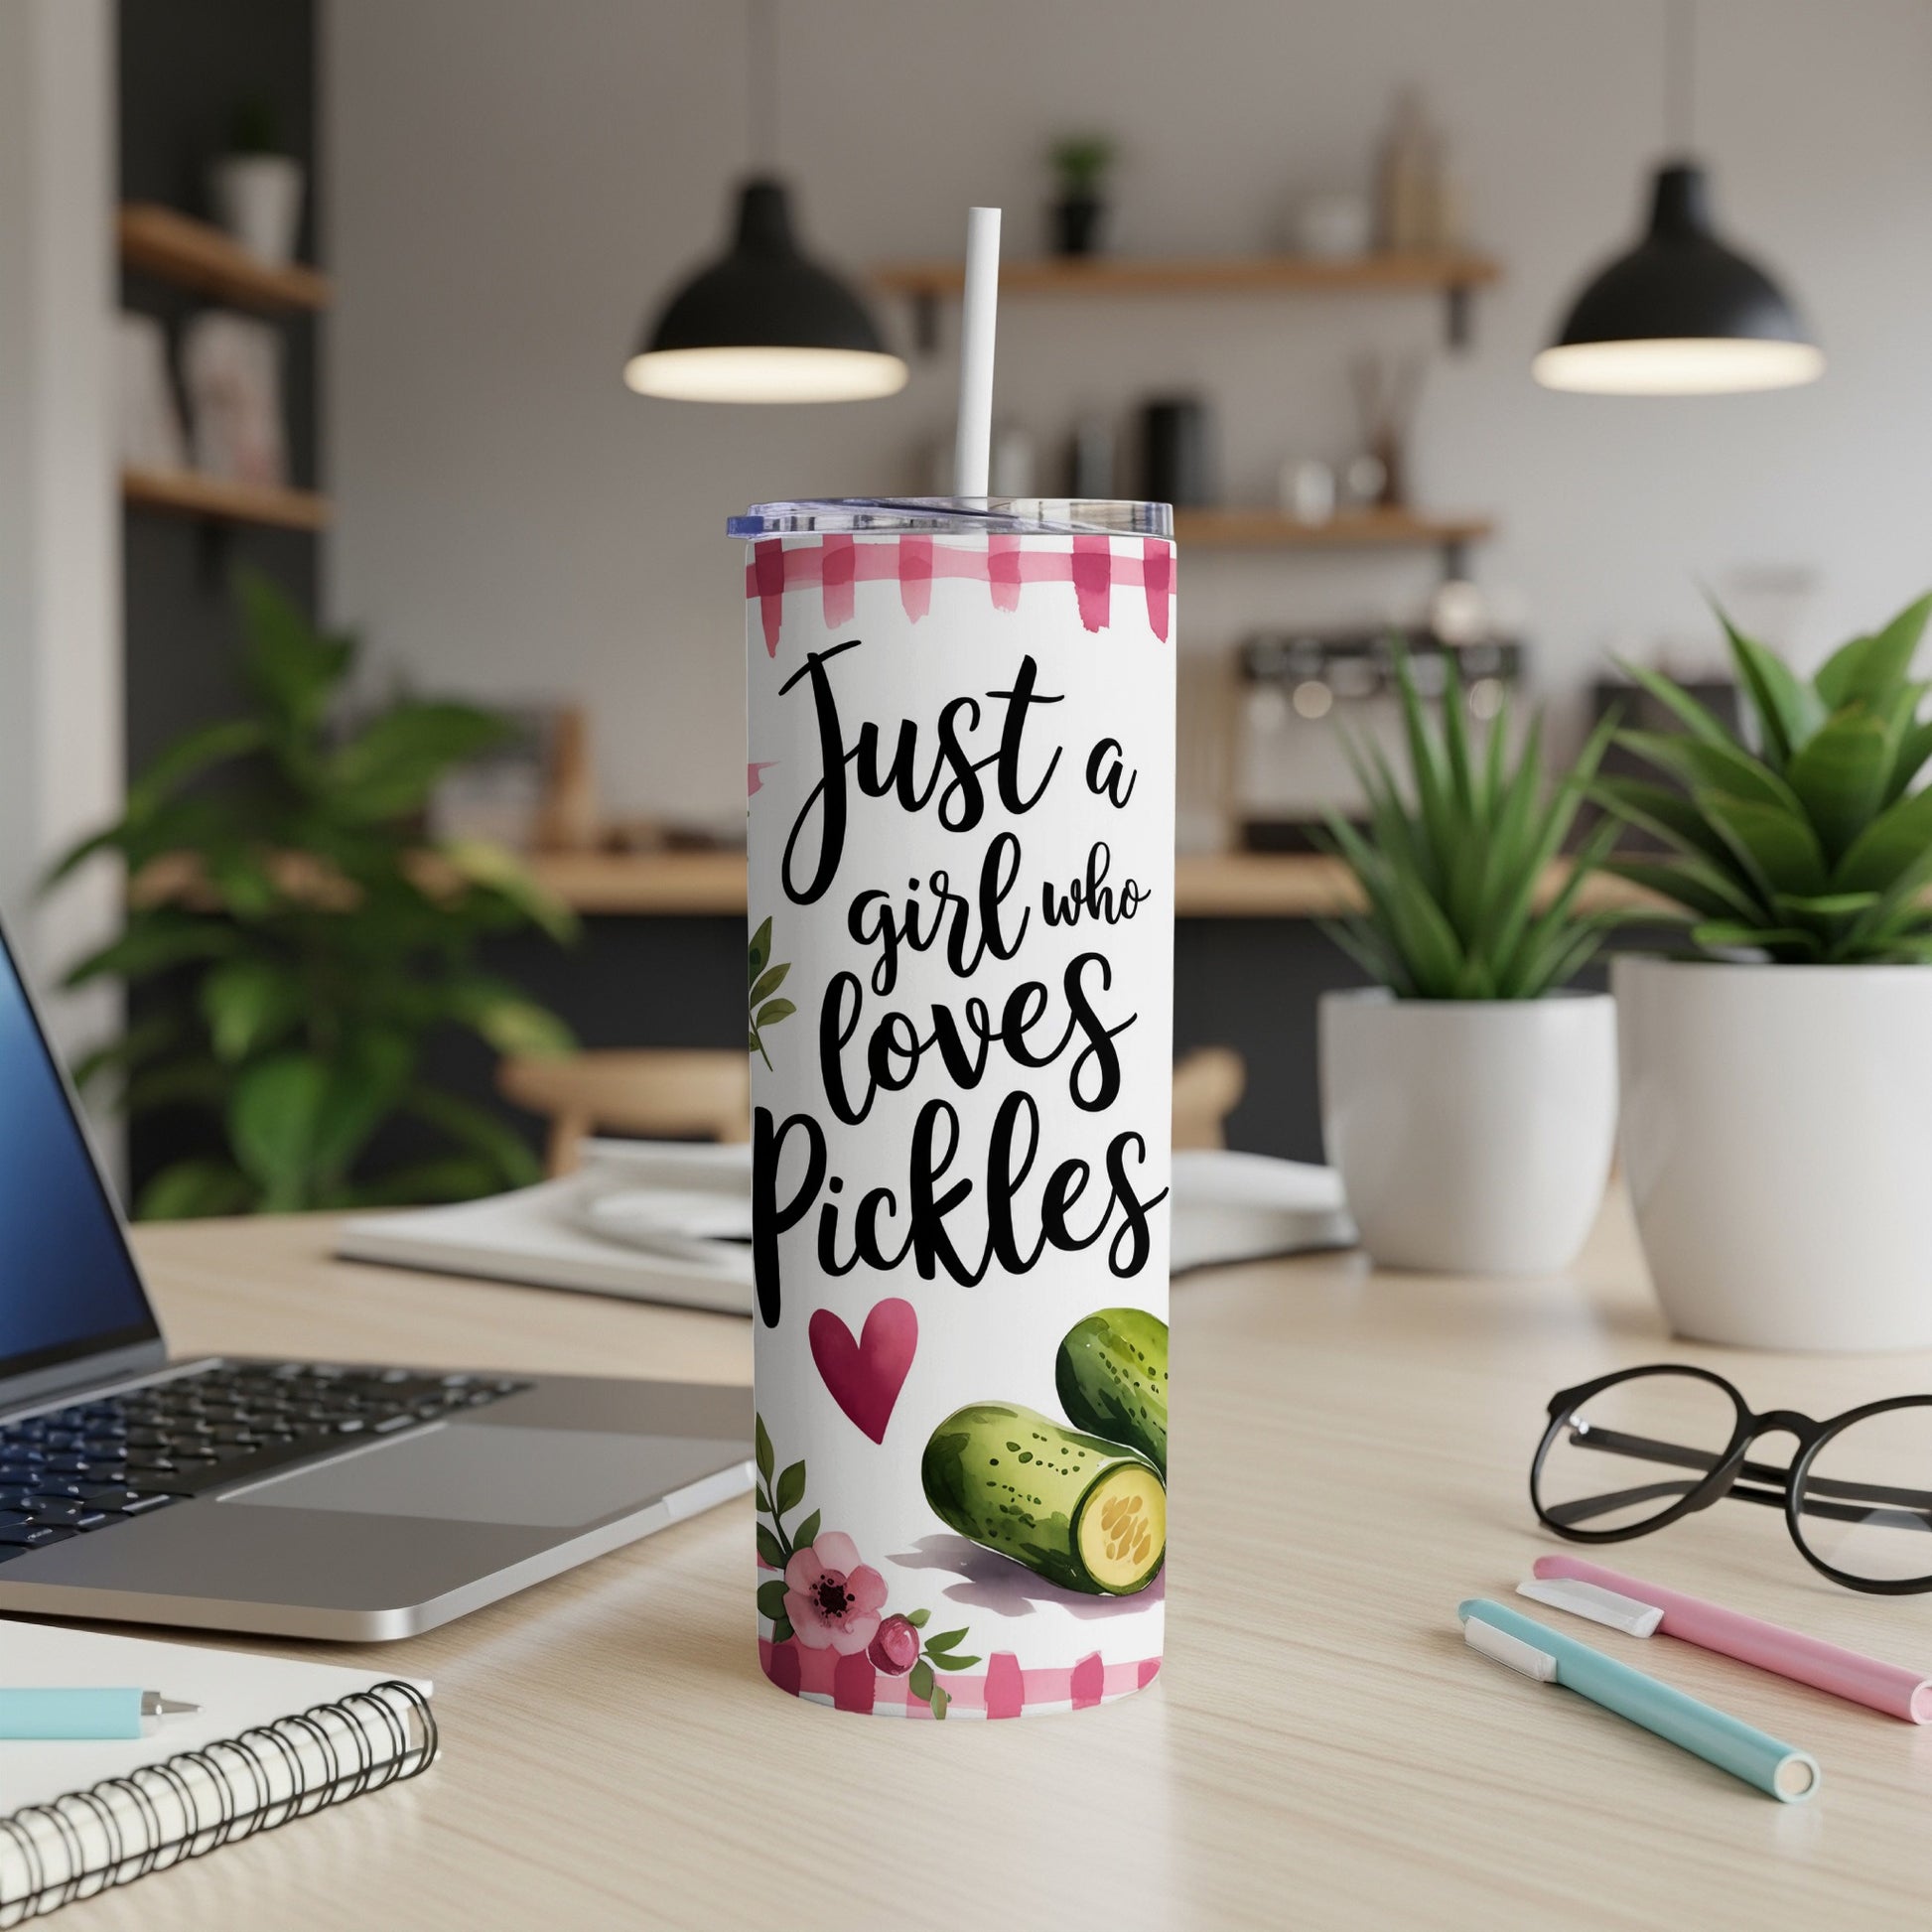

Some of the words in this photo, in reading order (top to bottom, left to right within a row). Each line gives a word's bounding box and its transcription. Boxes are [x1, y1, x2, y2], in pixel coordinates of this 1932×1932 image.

[778, 639, 1065, 906] Just
[1085, 738, 1138, 809] a
[847, 831, 1031, 997] girl
[1041, 841, 1152, 927] who
[819, 952, 1138, 1126] loves
[752, 1090, 1170, 1329] Pickles
